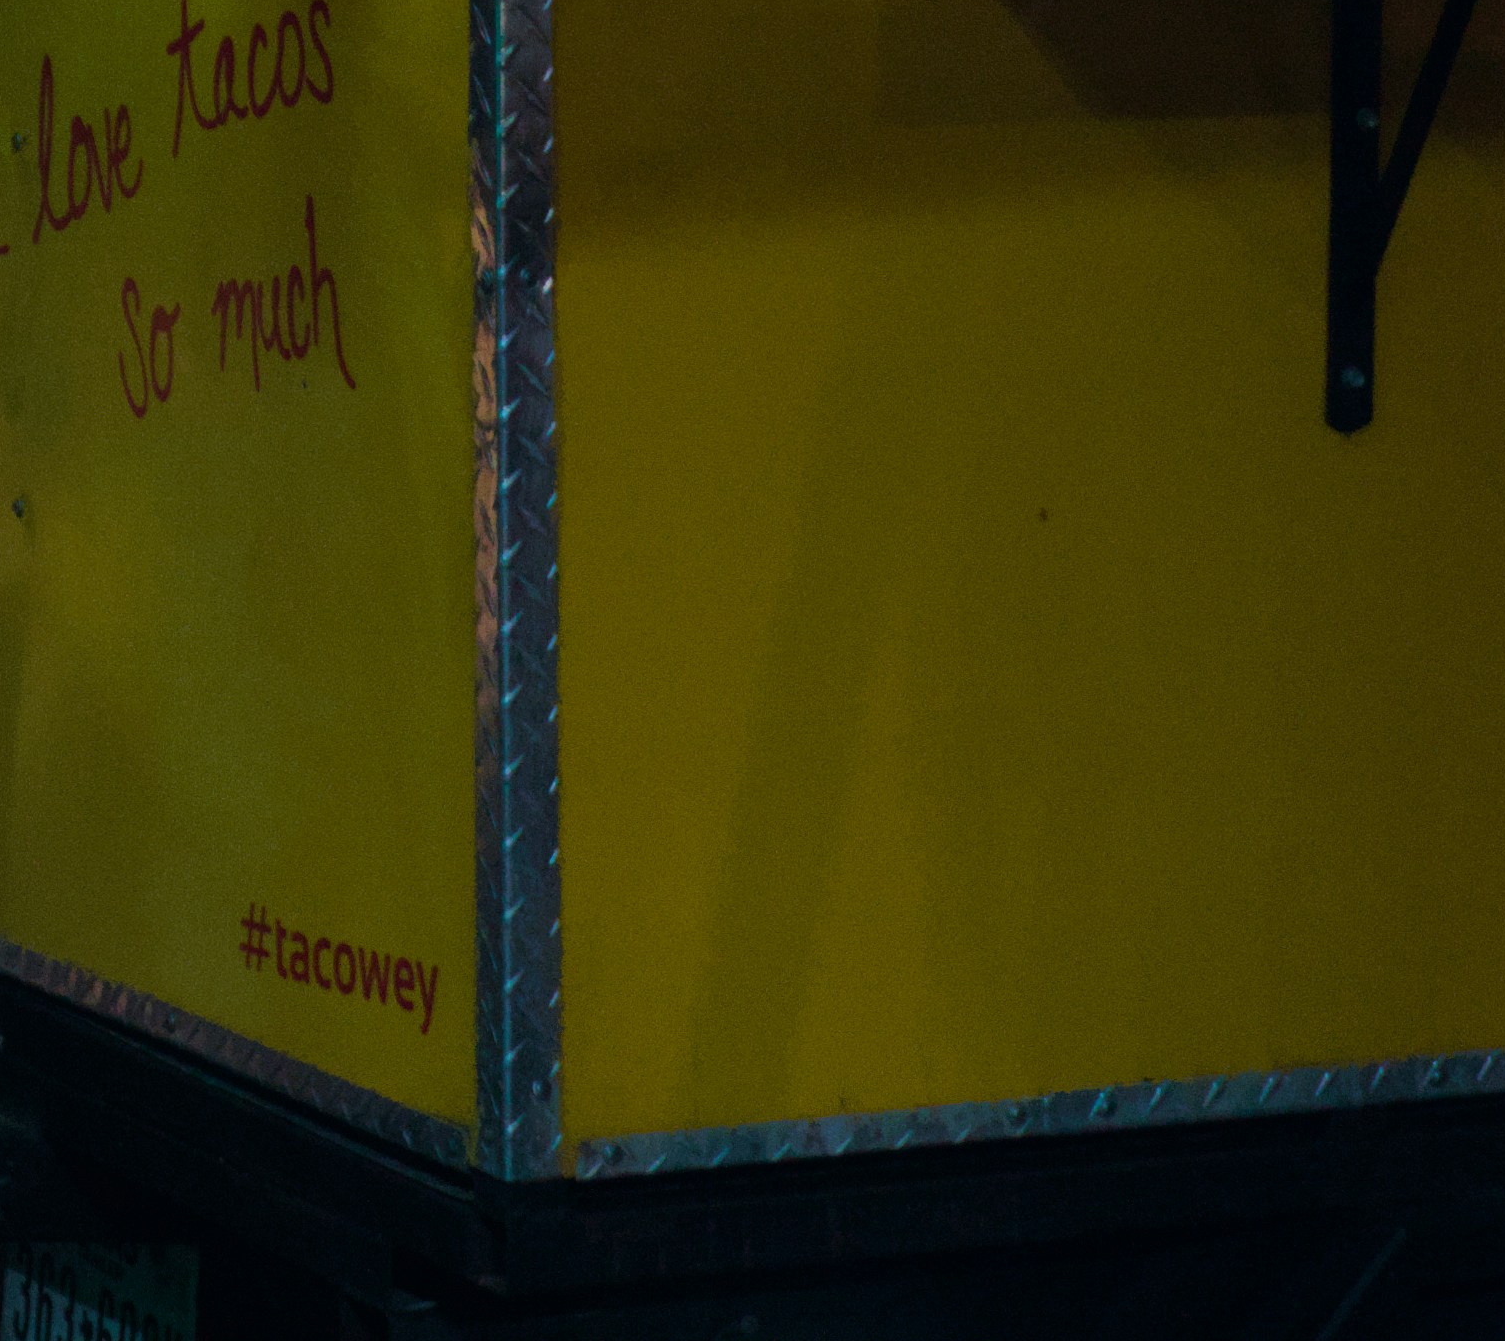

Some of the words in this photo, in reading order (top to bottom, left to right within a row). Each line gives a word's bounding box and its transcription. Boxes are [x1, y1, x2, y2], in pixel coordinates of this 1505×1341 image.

[32, 54, 144, 245] love
[211, 194, 357, 392] much
[240, 902, 438, 1035] #tacowey
